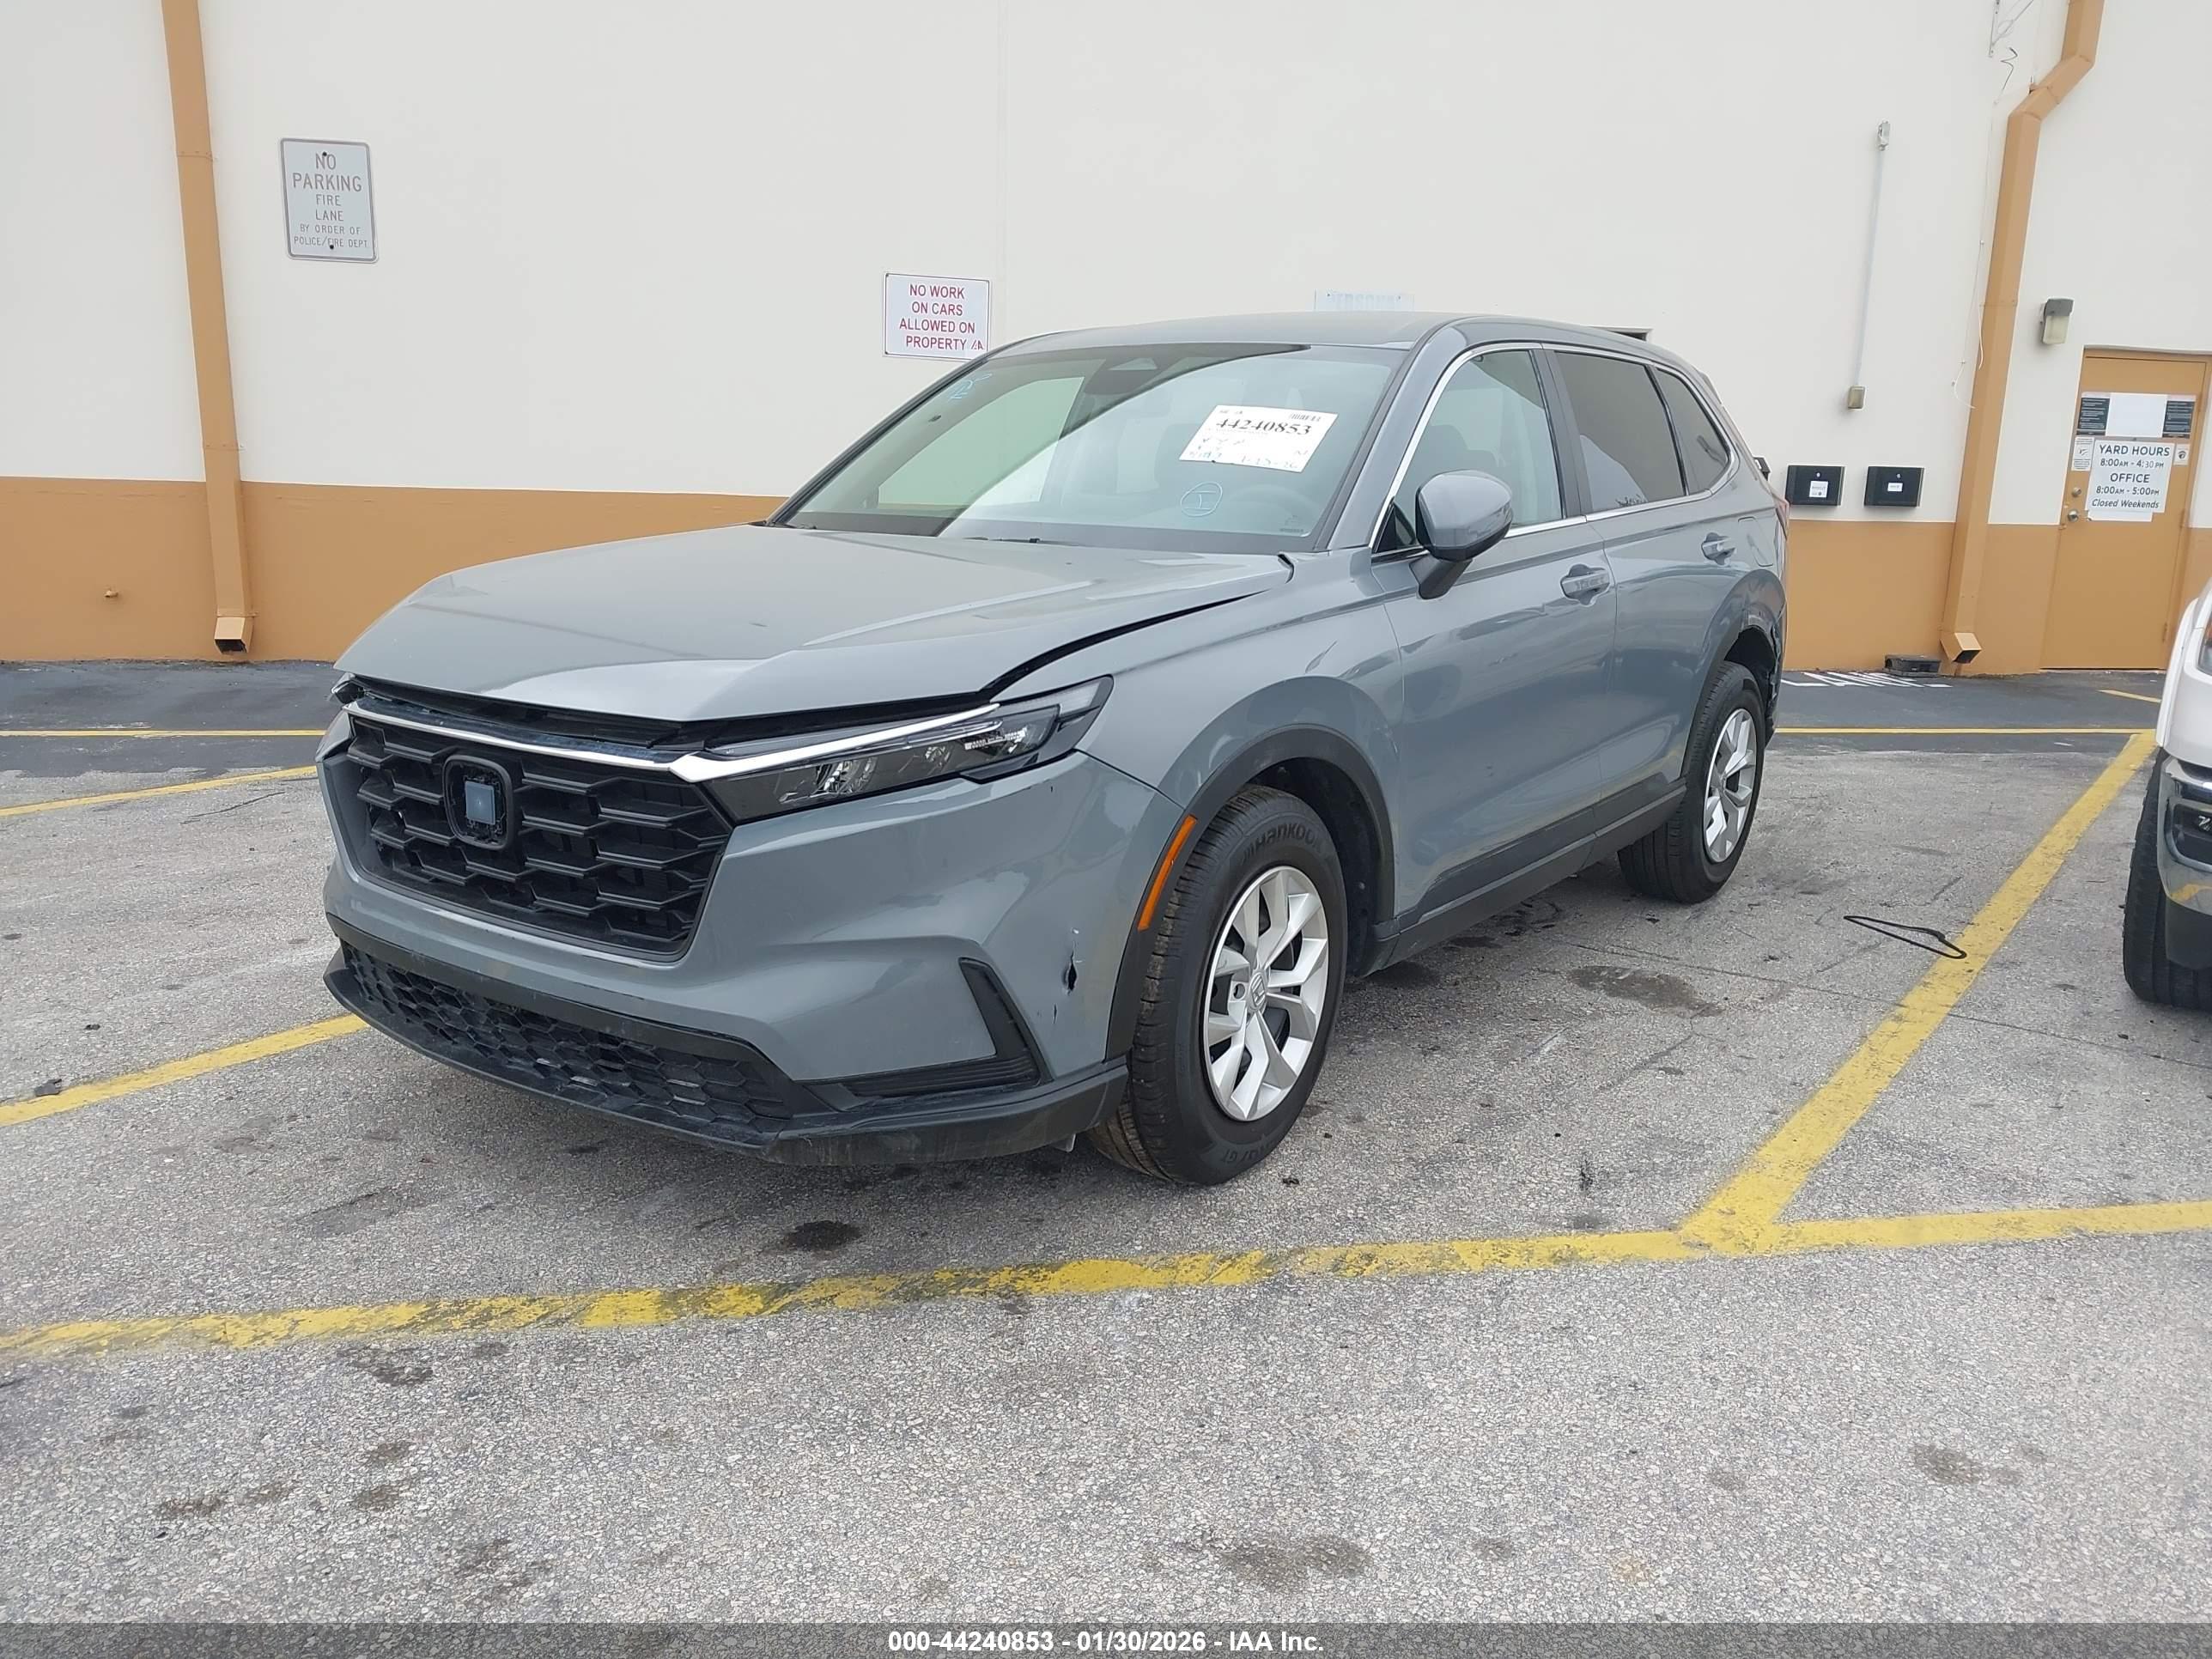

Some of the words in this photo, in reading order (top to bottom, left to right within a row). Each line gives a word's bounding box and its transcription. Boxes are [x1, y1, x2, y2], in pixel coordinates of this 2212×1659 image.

[315, 153, 337, 170] NO
[292, 172, 362, 192] PARKING
[315, 194, 342, 207] FIRE
[315, 210, 344, 222] LANE
[301, 224, 310, 233] BY
[314, 225, 345, 234] ORDER
[349, 227, 361, 235] OF
[348, 239, 368, 248] DEPT
[909, 283, 927, 296] NO
[929, 285, 965, 299] WORK
[911, 301, 928, 313] ON
[932, 302, 963, 316] CARS
[899, 318, 956, 332] ALLOWED
[958, 321, 975, 334] ON
[906, 335, 967, 350] PROPERTY
[1216, 418, 1312, 435] 44240853
[2099, 444, 2129, 455] YARD
[2131, 446, 2171, 457] HOURS
[2100, 459, 2129, 467] 8:00AM
[2110, 472, 2150, 483] OFFICE
[2095, 485, 2124, 495] 8:00AM
[2131, 487, 2160, 495] 5:00PM
[2092, 498, 2118, 507] Closed
[2121, 499, 2159, 508] Weekends
